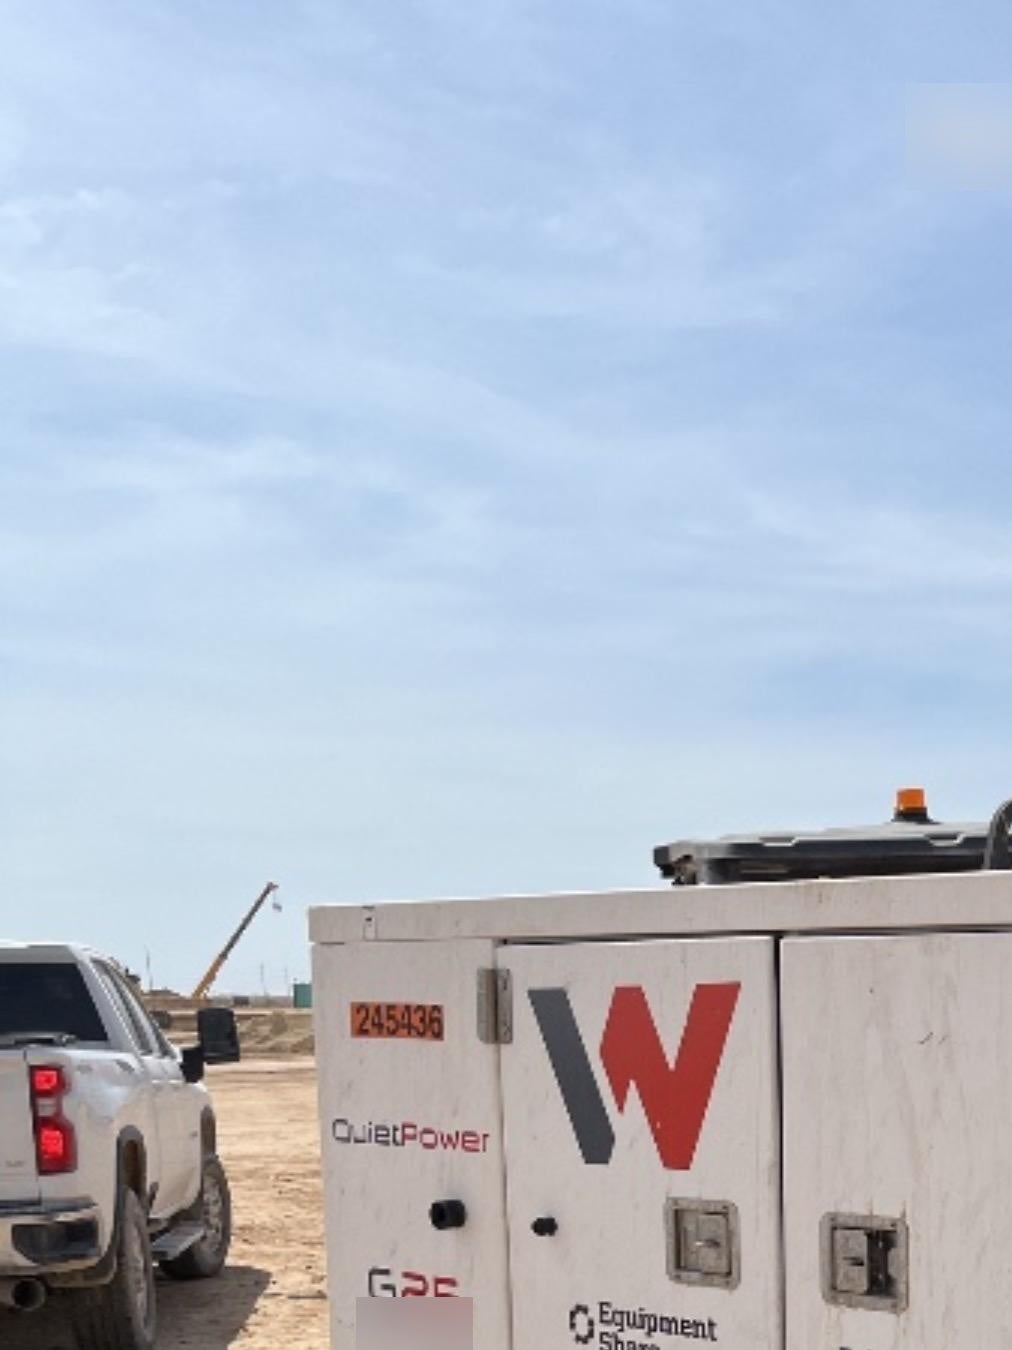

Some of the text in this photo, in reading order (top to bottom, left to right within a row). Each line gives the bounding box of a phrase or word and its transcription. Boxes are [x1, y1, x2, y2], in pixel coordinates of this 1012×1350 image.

[355, 1004, 443, 1039] 245436
[332, 1118, 490, 1153] QuietPower
[599, 1301, 718, 1342] Equipment
